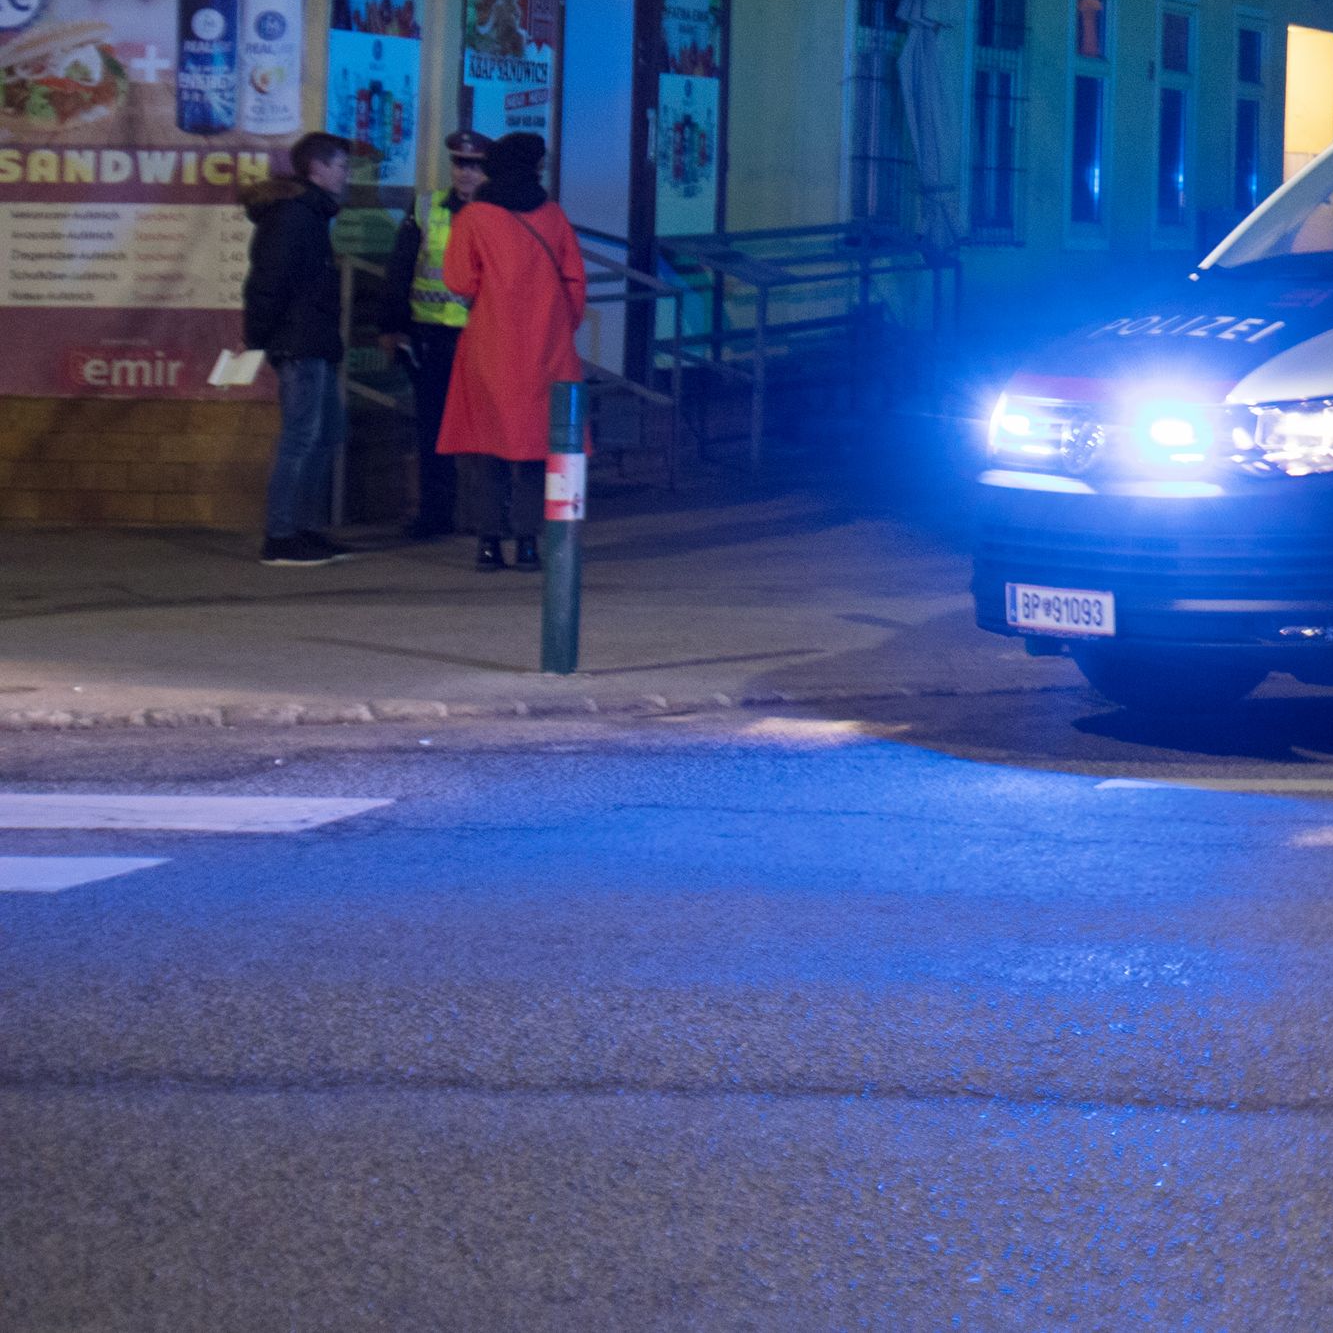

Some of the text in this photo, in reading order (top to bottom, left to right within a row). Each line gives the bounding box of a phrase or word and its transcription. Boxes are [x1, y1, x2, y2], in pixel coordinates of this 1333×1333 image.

[0, 149, 270, 185] SANDWICH
[1088, 315, 1285, 343] POLIZEI
[83, 350, 184, 387] emir
[1022, 592, 1103, 627] BP 91093
